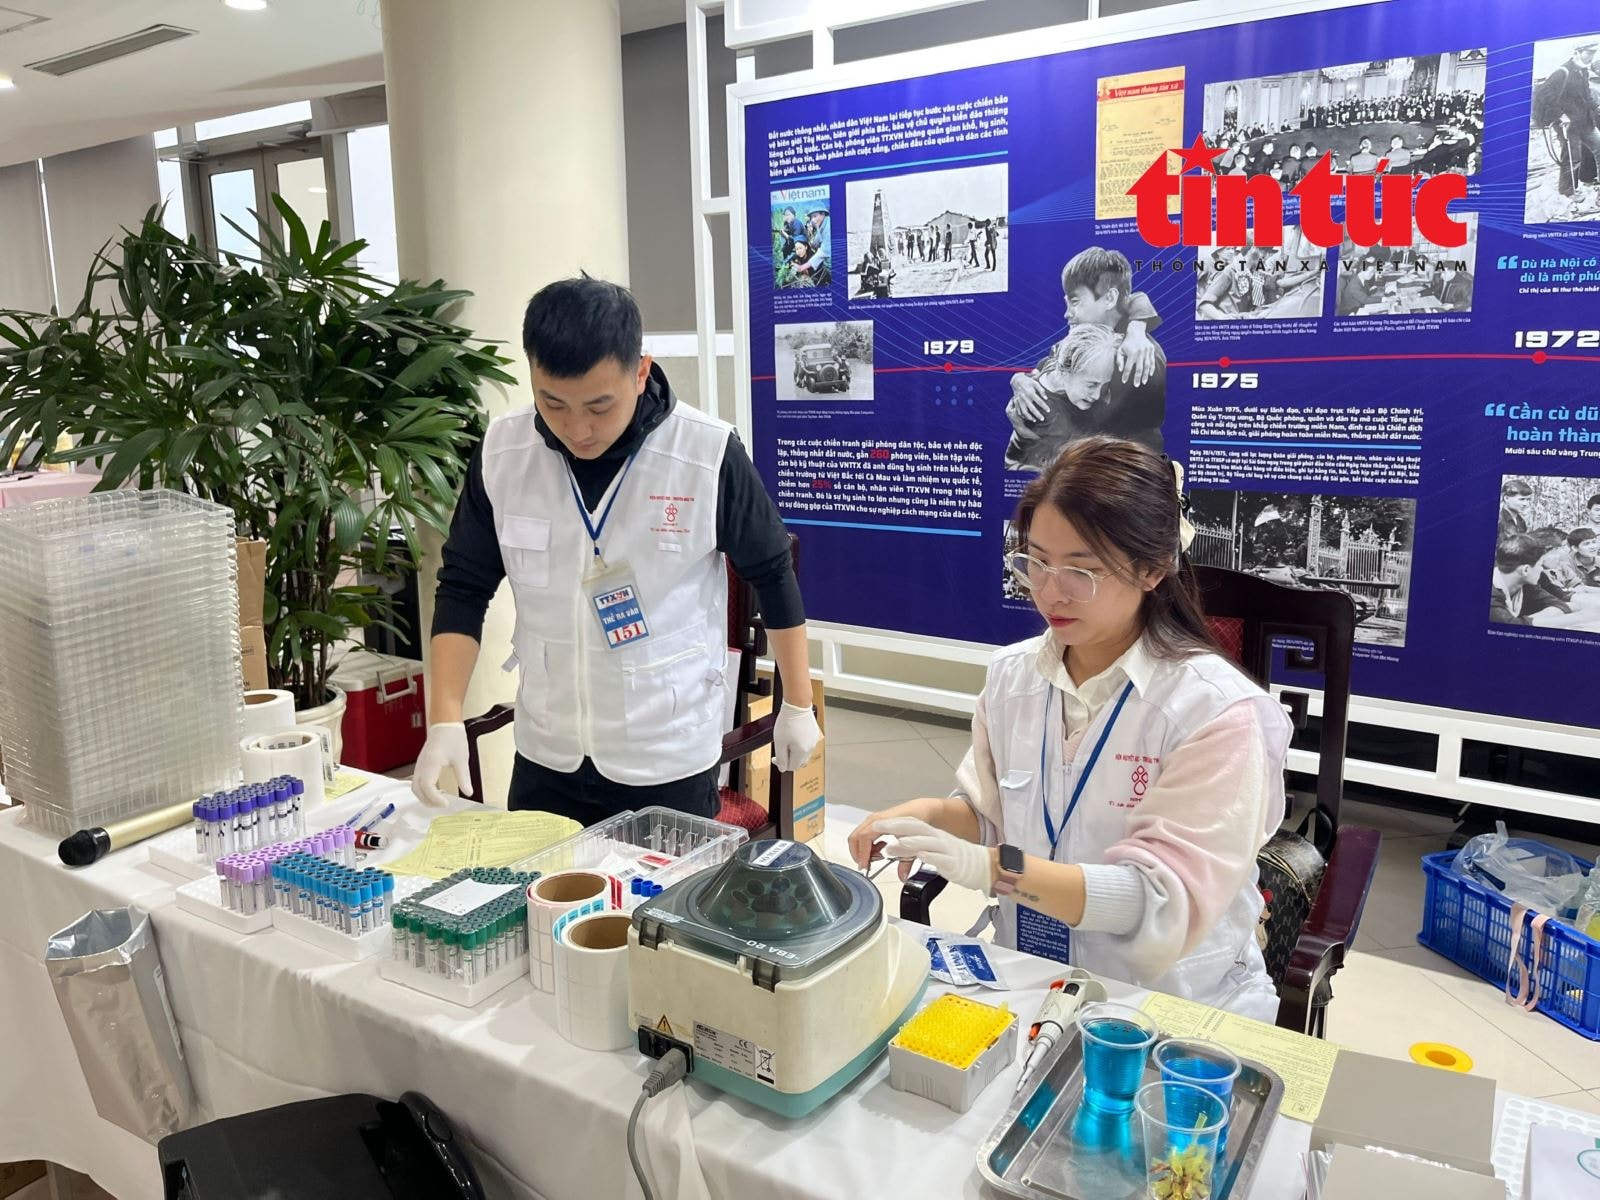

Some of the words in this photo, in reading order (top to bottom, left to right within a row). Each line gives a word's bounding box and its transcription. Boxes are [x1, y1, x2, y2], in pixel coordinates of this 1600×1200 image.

[858, 116, 872, 126] Việt
[873, 115, 888, 123] Nam
[1522, 259, 1537, 269] Dù
[1540, 258, 1556, 268] Hà
[1560, 258, 1580, 270] Nội
[1583, 257, 1596, 267] có
[1520, 272, 1535, 282] dù
[1538, 272, 1549, 282] là
[1552, 272, 1576, 283] một
[1515, 330, 1600, 348] 1972
[923, 340, 975, 355] 1979
[1192, 373, 1258, 388] 1975
[1509, 402, 1543, 420] Cần
[1548, 406, 1570, 420] cù
[1575, 406, 1600, 420] dũ
[1507, 426, 1553, 441] hoàn
[1542, 448, 1557, 456] chữ
[1559, 448, 1578, 458] vàng
[906, 485, 930, 493] TTXVN
[612, 622, 642, 642] 151
